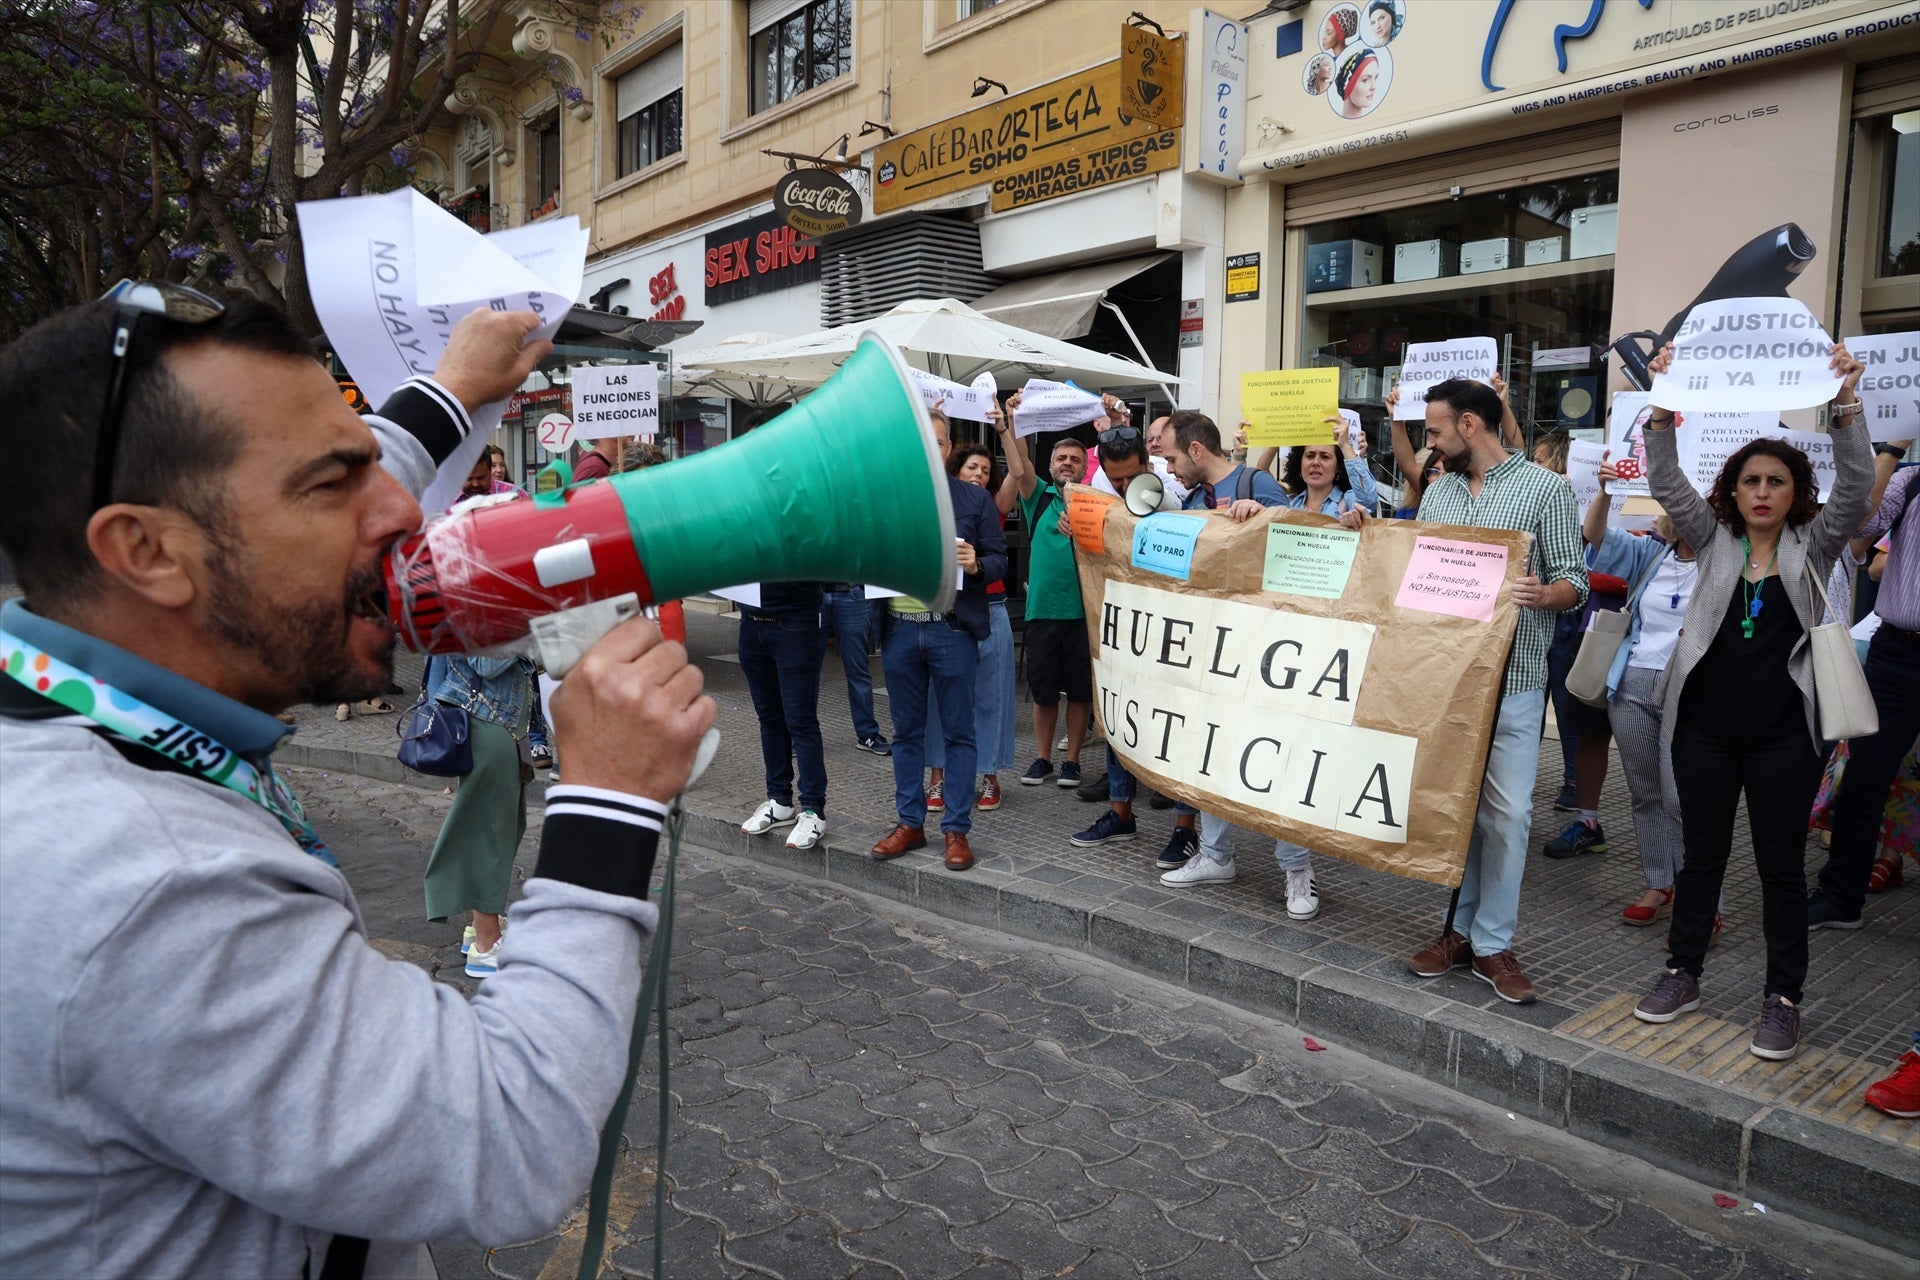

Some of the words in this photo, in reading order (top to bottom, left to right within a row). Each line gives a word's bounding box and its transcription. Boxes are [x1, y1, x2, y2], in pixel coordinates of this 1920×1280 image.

[1633, 20, 1711, 50] ARTICULOS
[1715, 14, 1735, 32] DE
[1512, 101, 1540, 115] WIGS
[1543, 96, 1566, 109] AND
[1645, 65, 1695, 85] BEAUTY
[1699, 58, 1726, 73] AND
[1732, 32, 1838, 65] HAIRDRESSING
[998, 85, 1101, 147] ORTEGA
[1274, 156, 1291, 168] 952
[1294, 153, 1305, 165] 22
[1308, 149, 1320, 161] 50
[1323, 146, 1335, 157] 10
[1343, 140, 1361, 153] 952
[1364, 136, 1377, 148] 22
[1379, 132, 1393, 144] 56
[1396, 129, 1409, 140] 51
[969, 144, 1027, 175] SOHO
[993, 157, 1080, 195] COMIDAS
[1088, 132, 1175, 168] TIPICAS
[1013, 157, 1147, 204] PARAGUAYAS
[792, 215, 822, 231] ORTEGA
[373, 240, 398, 284] NO
[705, 237, 750, 288] SEX
[649, 262, 678, 306] SEX
[379, 297, 427, 358] HAY
[1711, 313, 1822, 333] JUSTICI
[1422, 349, 1490, 363] JUSTICIA
[606, 375, 628, 386] LAS
[1301, 378, 1332, 386] JUSTICIA
[1726, 372, 1755, 386] YA
[583, 391, 651, 405] FUNCIONES
[939, 388, 954, 400] YA
[1280, 389, 1305, 397] HUELGA
[578, 412, 592, 423] SE
[597, 408, 657, 421] NEGOCIAN
[541, 421, 573, 445] 27
[1152, 543, 1162, 553] YO
[1164, 546, 1184, 557] PARO
[1475, 550, 1504, 559] JUSTICIA
[1450, 559, 1477, 568] HUELGA
[1426, 572, 1440, 581] Sin
[1408, 582, 1423, 591] NO
[1423, 585, 1442, 594] HAY
[1441, 589, 1481, 600] JUSTICIA
[1102, 602, 1352, 702] HUELGA
[140, 722, 226, 771] CSIF
